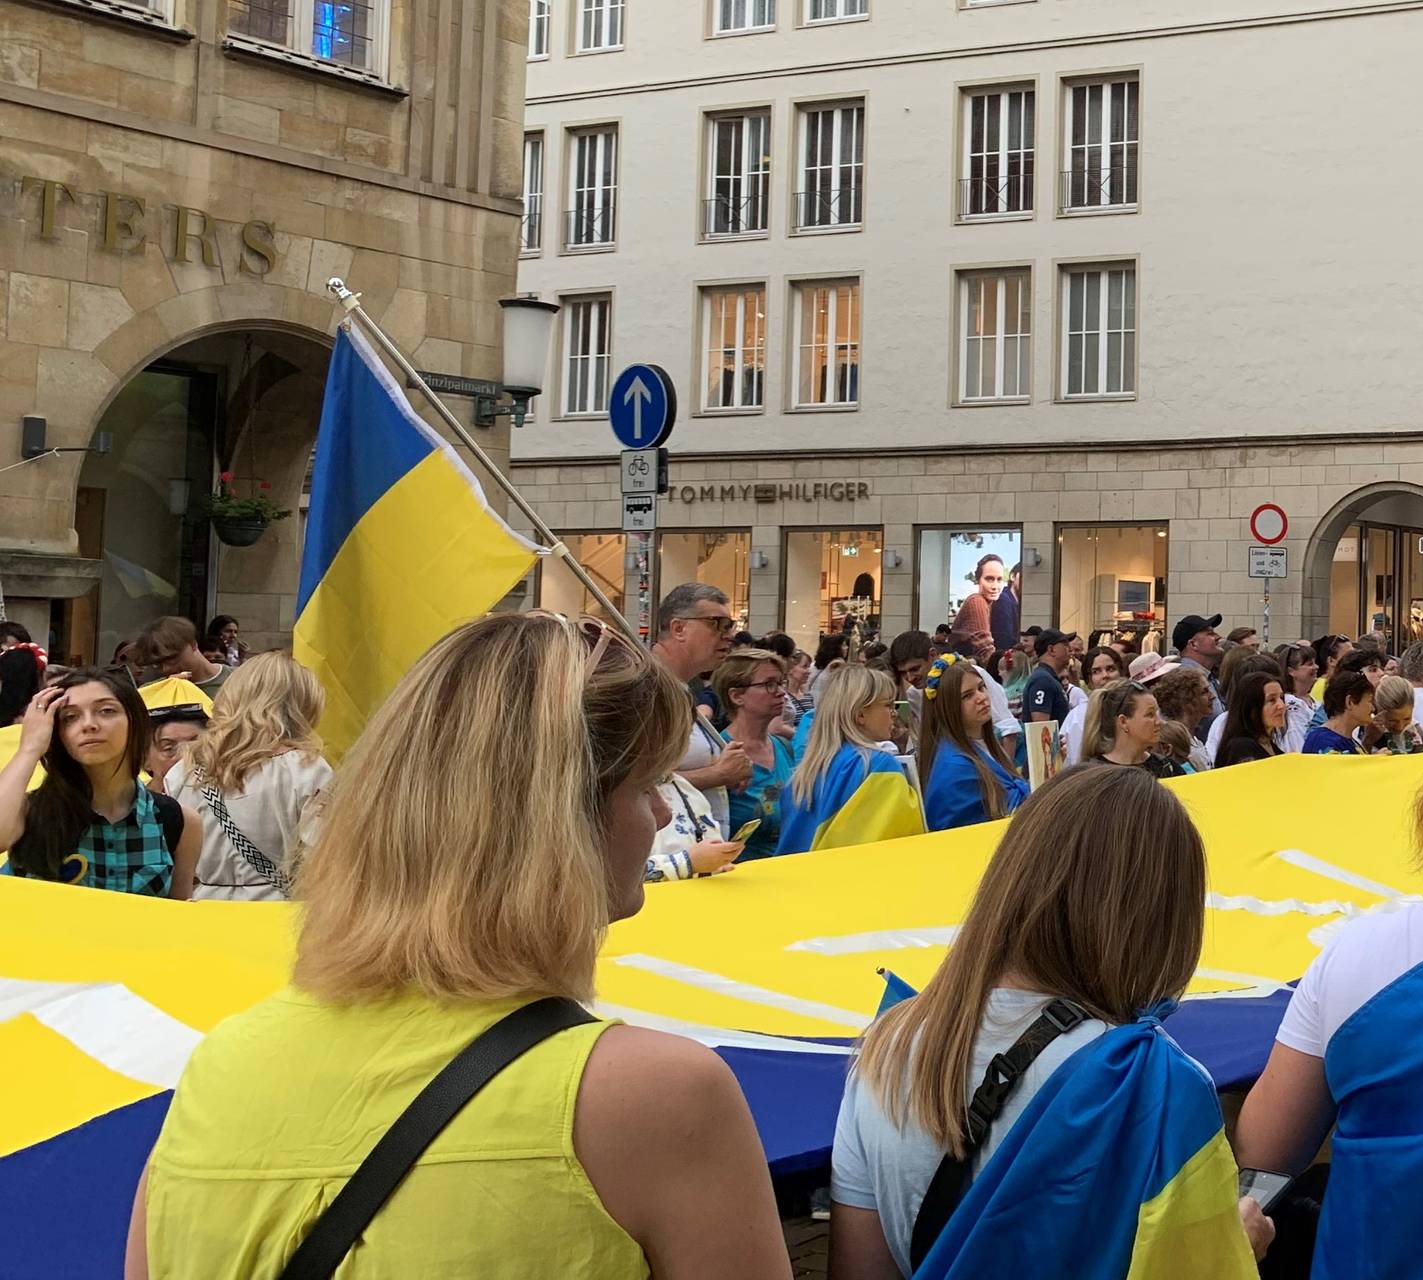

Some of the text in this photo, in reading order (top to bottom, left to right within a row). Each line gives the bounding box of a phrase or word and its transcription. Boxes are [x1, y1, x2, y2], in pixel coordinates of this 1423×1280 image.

[22, 176, 276, 275] TERS
[421, 373, 496, 396] rinzipalmarkt
[668, 482, 870, 504] TOMMY HILFIGER
[1035, 690, 1045, 704] 3
